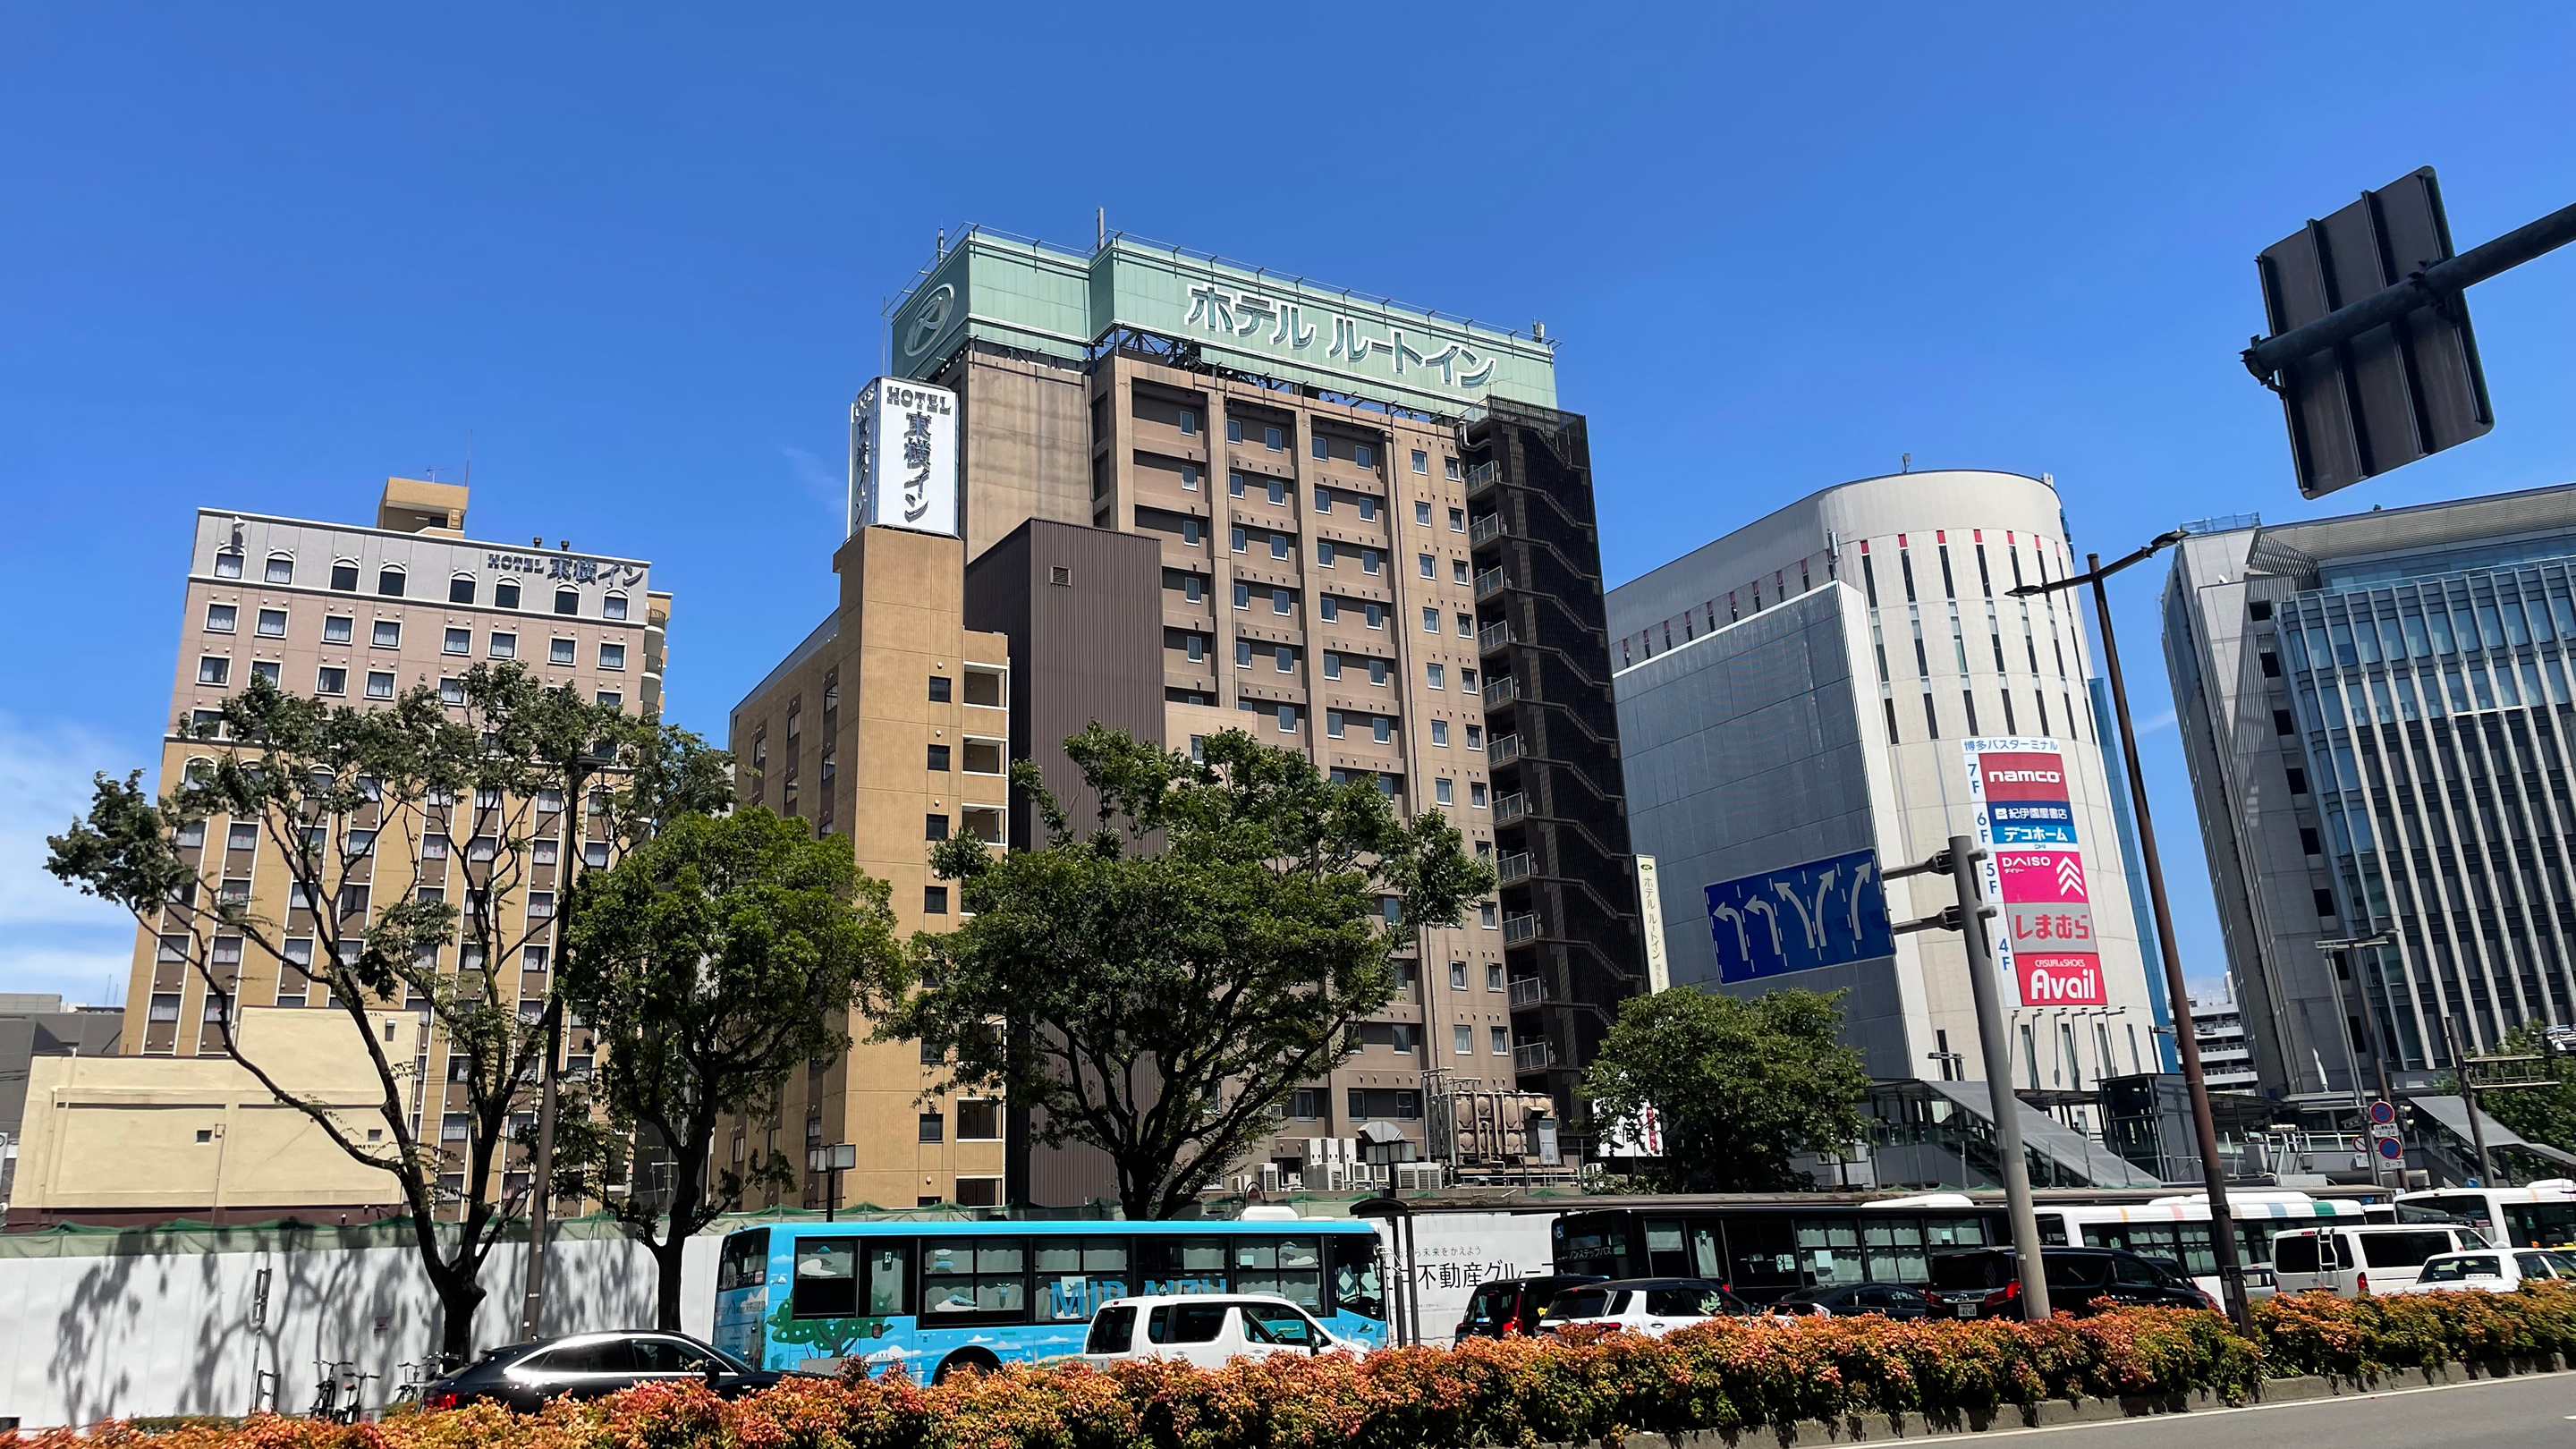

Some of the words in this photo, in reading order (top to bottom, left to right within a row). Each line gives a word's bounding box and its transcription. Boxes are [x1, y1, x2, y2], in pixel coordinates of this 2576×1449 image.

[1184, 282, 1317, 350] ホテル
[1326, 313, 1496, 388] ルートイン
[886, 386, 952, 416] HOTEL
[903, 411, 932, 523] 東横イン
[487, 553, 545, 574] HOTEL
[547, 555, 644, 588] 東横イン
[1964, 740, 2058, 751] 博多バスターミナル
[1988, 770, 2060, 783] namco
[2004, 826, 2069, 843] デコホーム
[2002, 856, 2051, 868] DAISO
[1643, 877, 1656, 910] ホテル
[1648, 913, 1661, 960] ルートイン
[2015, 914, 2089, 940] しまむら
[2030, 969, 2097, 1000] Avail
